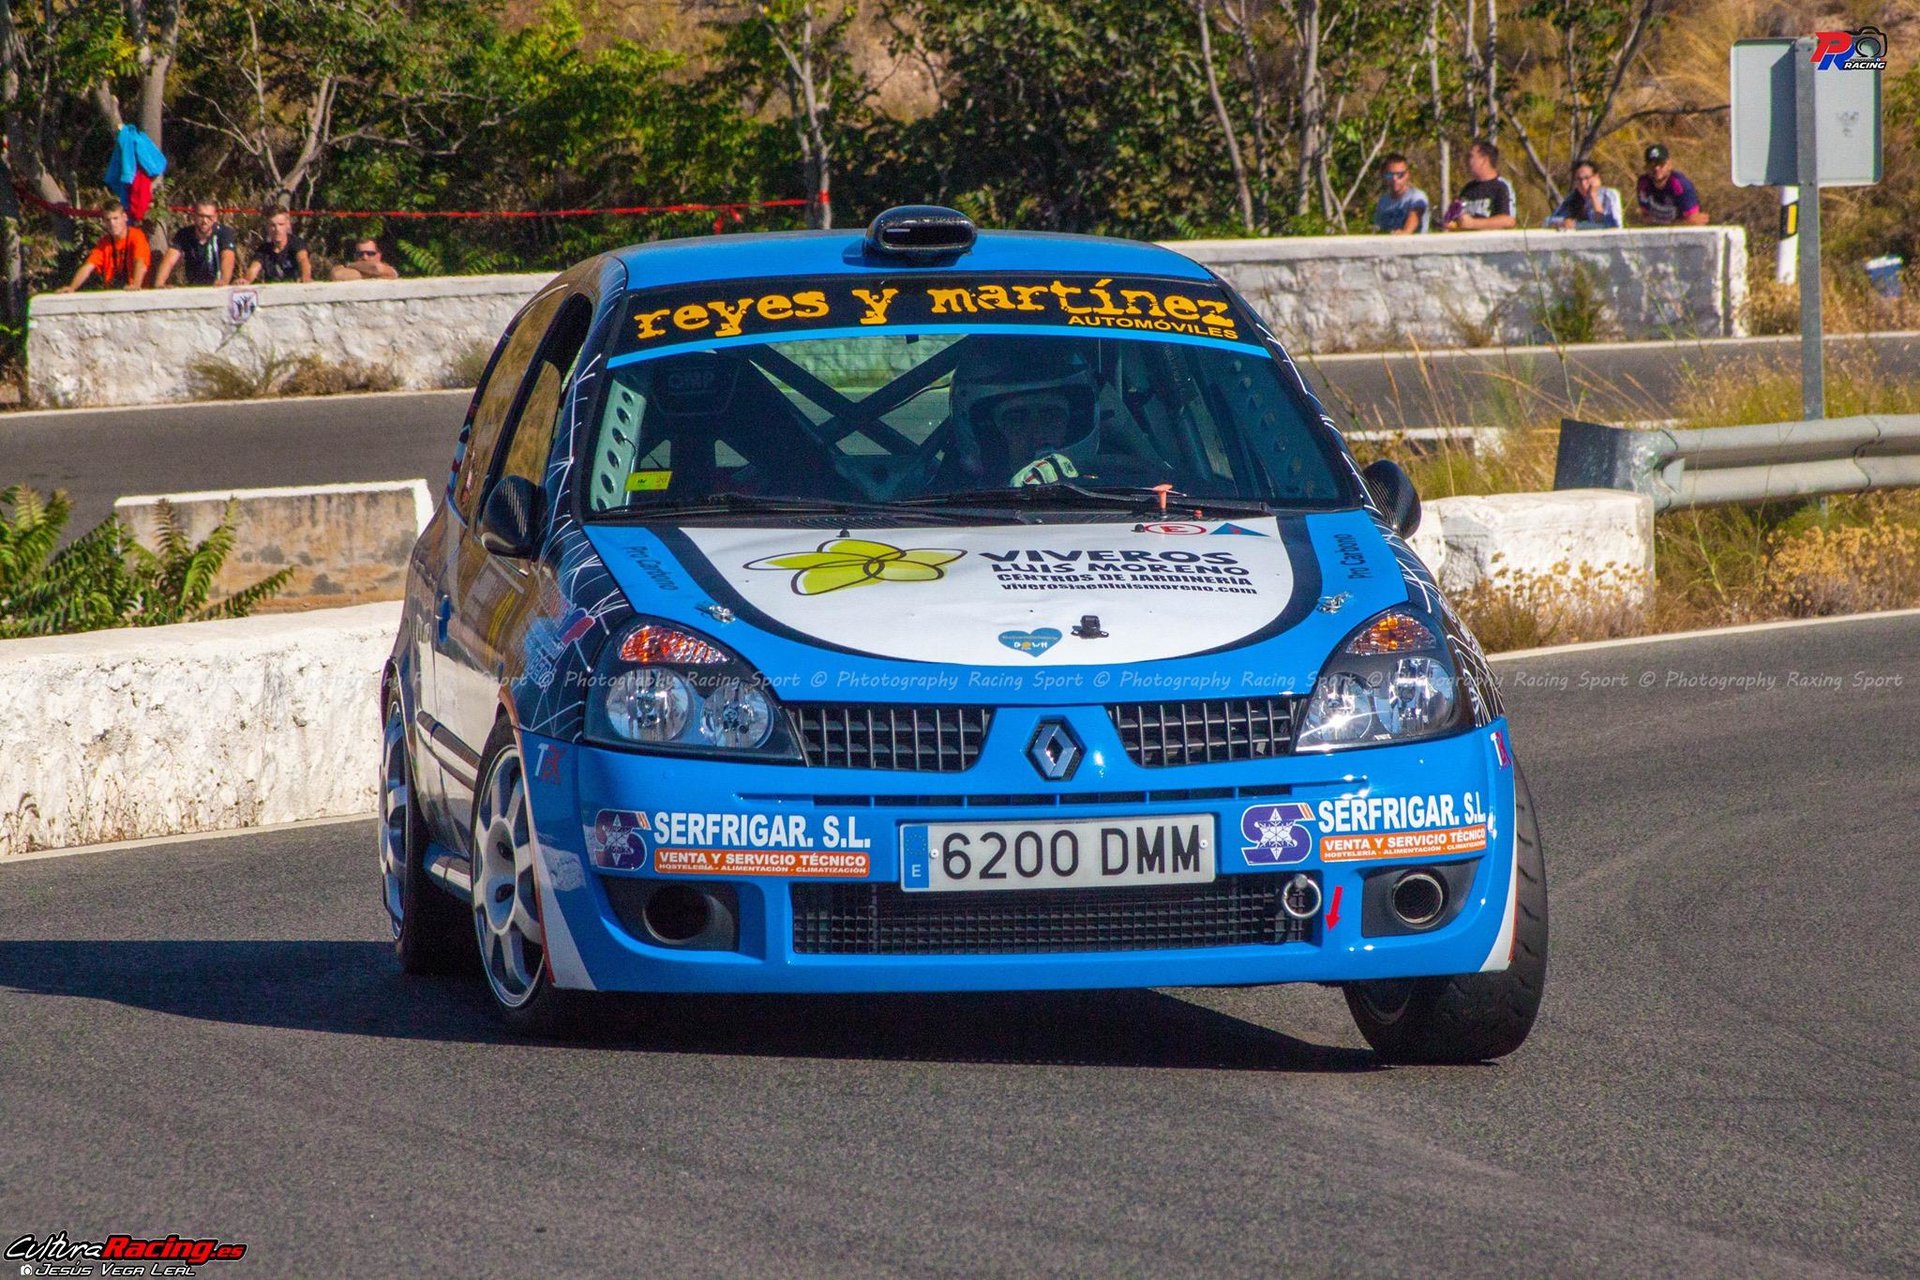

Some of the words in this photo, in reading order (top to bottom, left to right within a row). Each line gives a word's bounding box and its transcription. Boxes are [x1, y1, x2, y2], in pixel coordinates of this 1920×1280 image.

[634, 290, 830, 339] reyes
[852, 288, 899, 325] y
[927, 278, 1235, 328] martínez
[1067, 315, 1239, 340] AUTOMÓVILES
[979, 549, 1239, 565] VIVEROS
[991, 563, 1076, 573] LUIS
[1087, 563, 1251, 576] MORENO
[997, 573, 1094, 582] CENTROS
[1099, 573, 1125, 582] DE
[1129, 574, 1254, 587] JARDINERÍA
[1318, 794, 1459, 833] SERFRIGAR.
[654, 811, 813, 848] SERFRIGAR.
[823, 815, 871, 848] S.L.
[1325, 839, 1370, 851] VENTA
[1374, 838, 1384, 848] Y
[1388, 833, 1447, 848] SERVICIO
[1450, 828, 1485, 843] TÉCNICO
[660, 852, 705, 864] VENTA
[711, 853, 721, 864] Y
[726, 853, 796, 866] SERVICIO
[800, 852, 867, 867] TÉCNICO
[942, 829, 1079, 881] 6200
[1100, 824, 1200, 876] DMM
[1324, 849, 1376, 858] HOSTELERÍA
[1383, 846, 1441, 855] ALIMENTACIÓN
[720, 865, 788, 873] ALIMENTACIÓN
[911, 864, 922, 877] E
